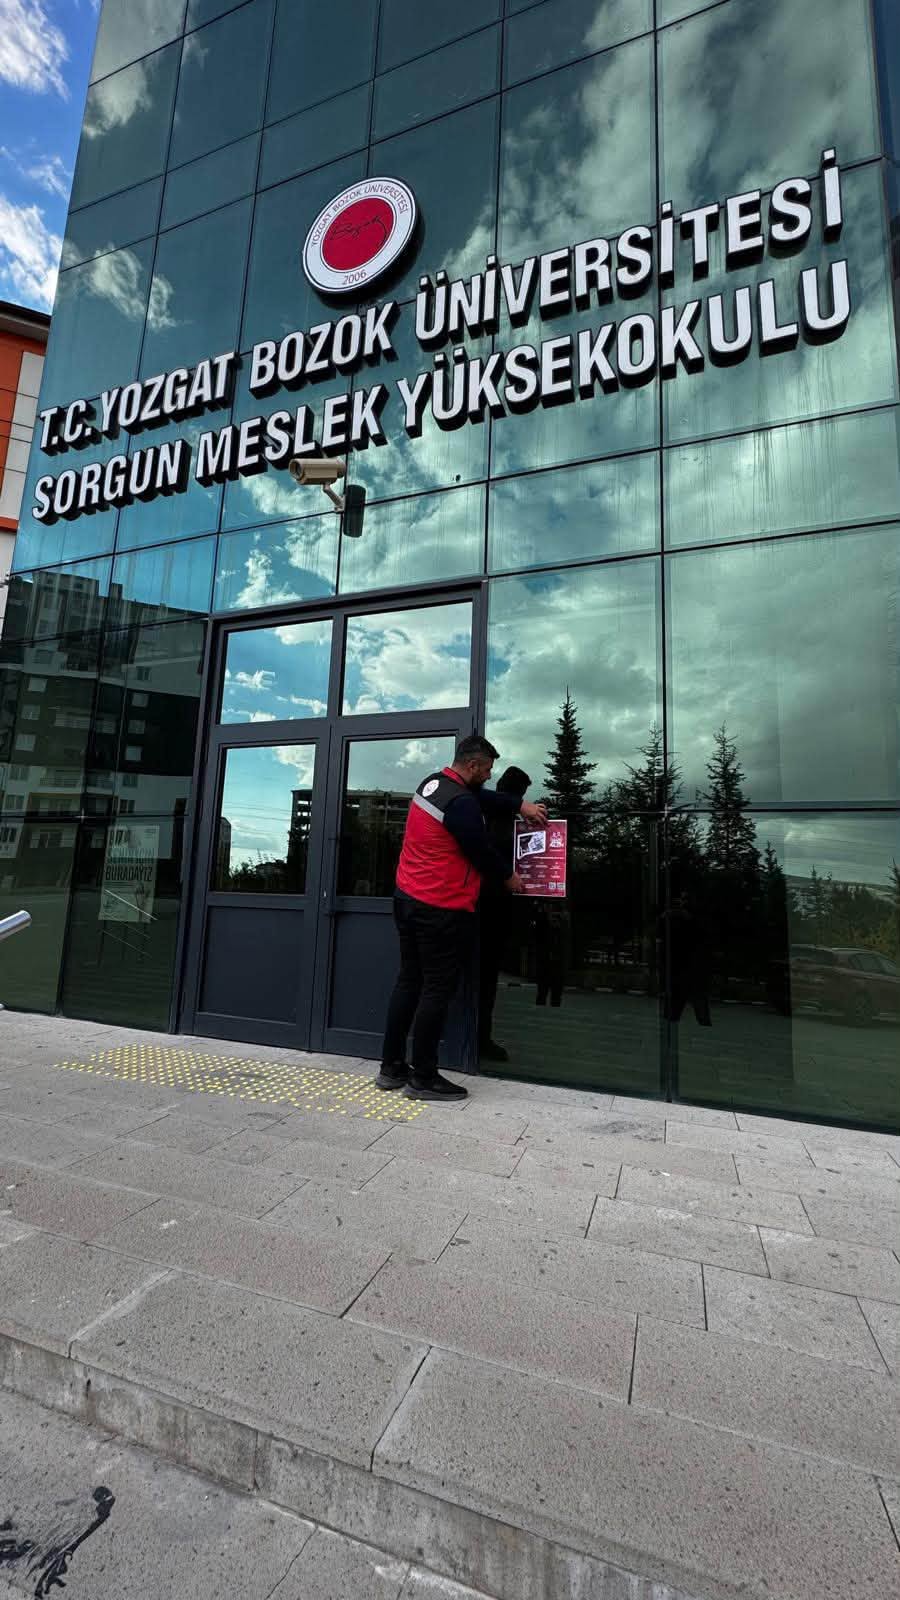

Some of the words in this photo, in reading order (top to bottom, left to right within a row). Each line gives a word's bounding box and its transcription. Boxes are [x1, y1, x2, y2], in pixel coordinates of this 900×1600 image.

[100, 353, 235, 433] YOZGAT
[249, 301, 396, 391] BOZOK
[414, 147, 843, 342] ÜNİVERSİTESİ
[311, 213, 333, 247] YOZGAT
[332, 190, 362, 213] BOZOK
[342, 269, 367, 286] 2006
[31, 439, 184, 522] SORGUN
[195, 384, 384, 480] MESLEK
[395, 258, 851, 430] YÜKSEKOKULU
